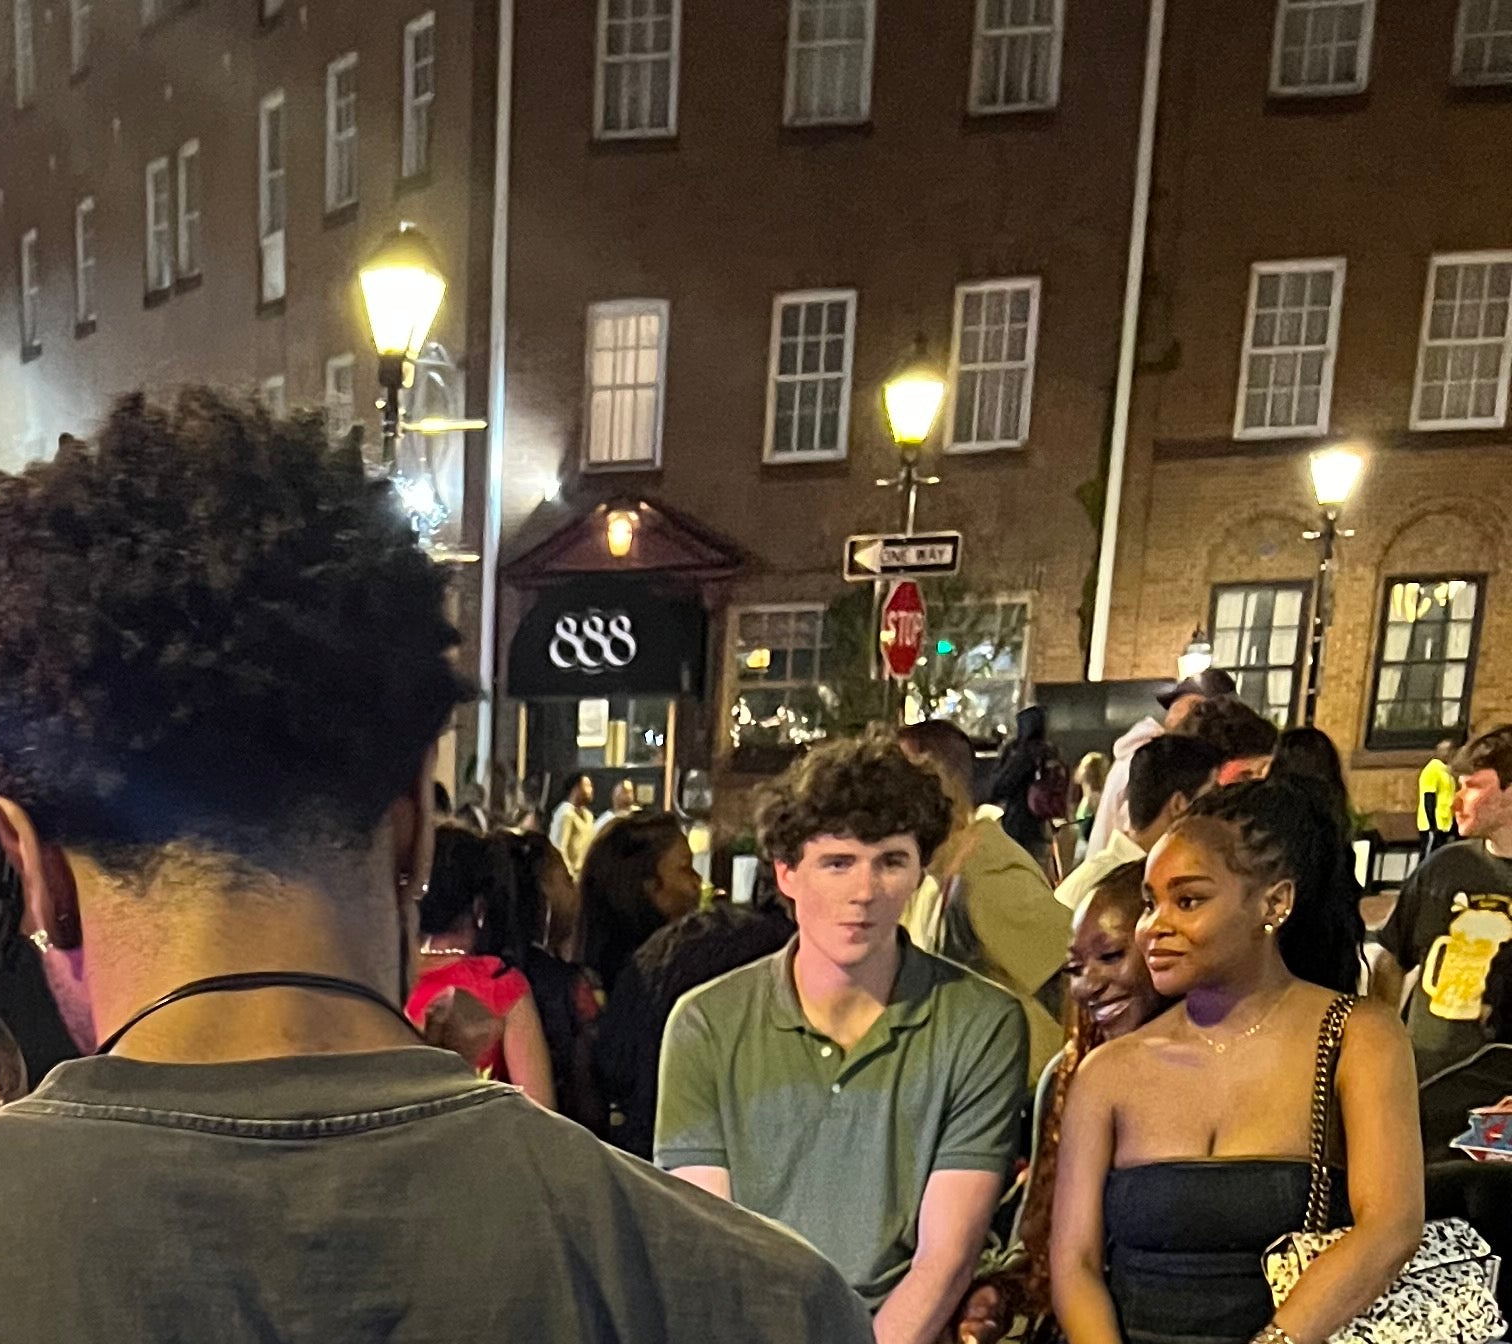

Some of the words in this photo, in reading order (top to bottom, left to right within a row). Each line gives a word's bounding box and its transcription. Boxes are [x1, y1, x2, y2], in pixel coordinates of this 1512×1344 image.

[915, 547, 947, 561] WAY
[549, 614, 637, 669] 888
[887, 610, 924, 646] STOP
